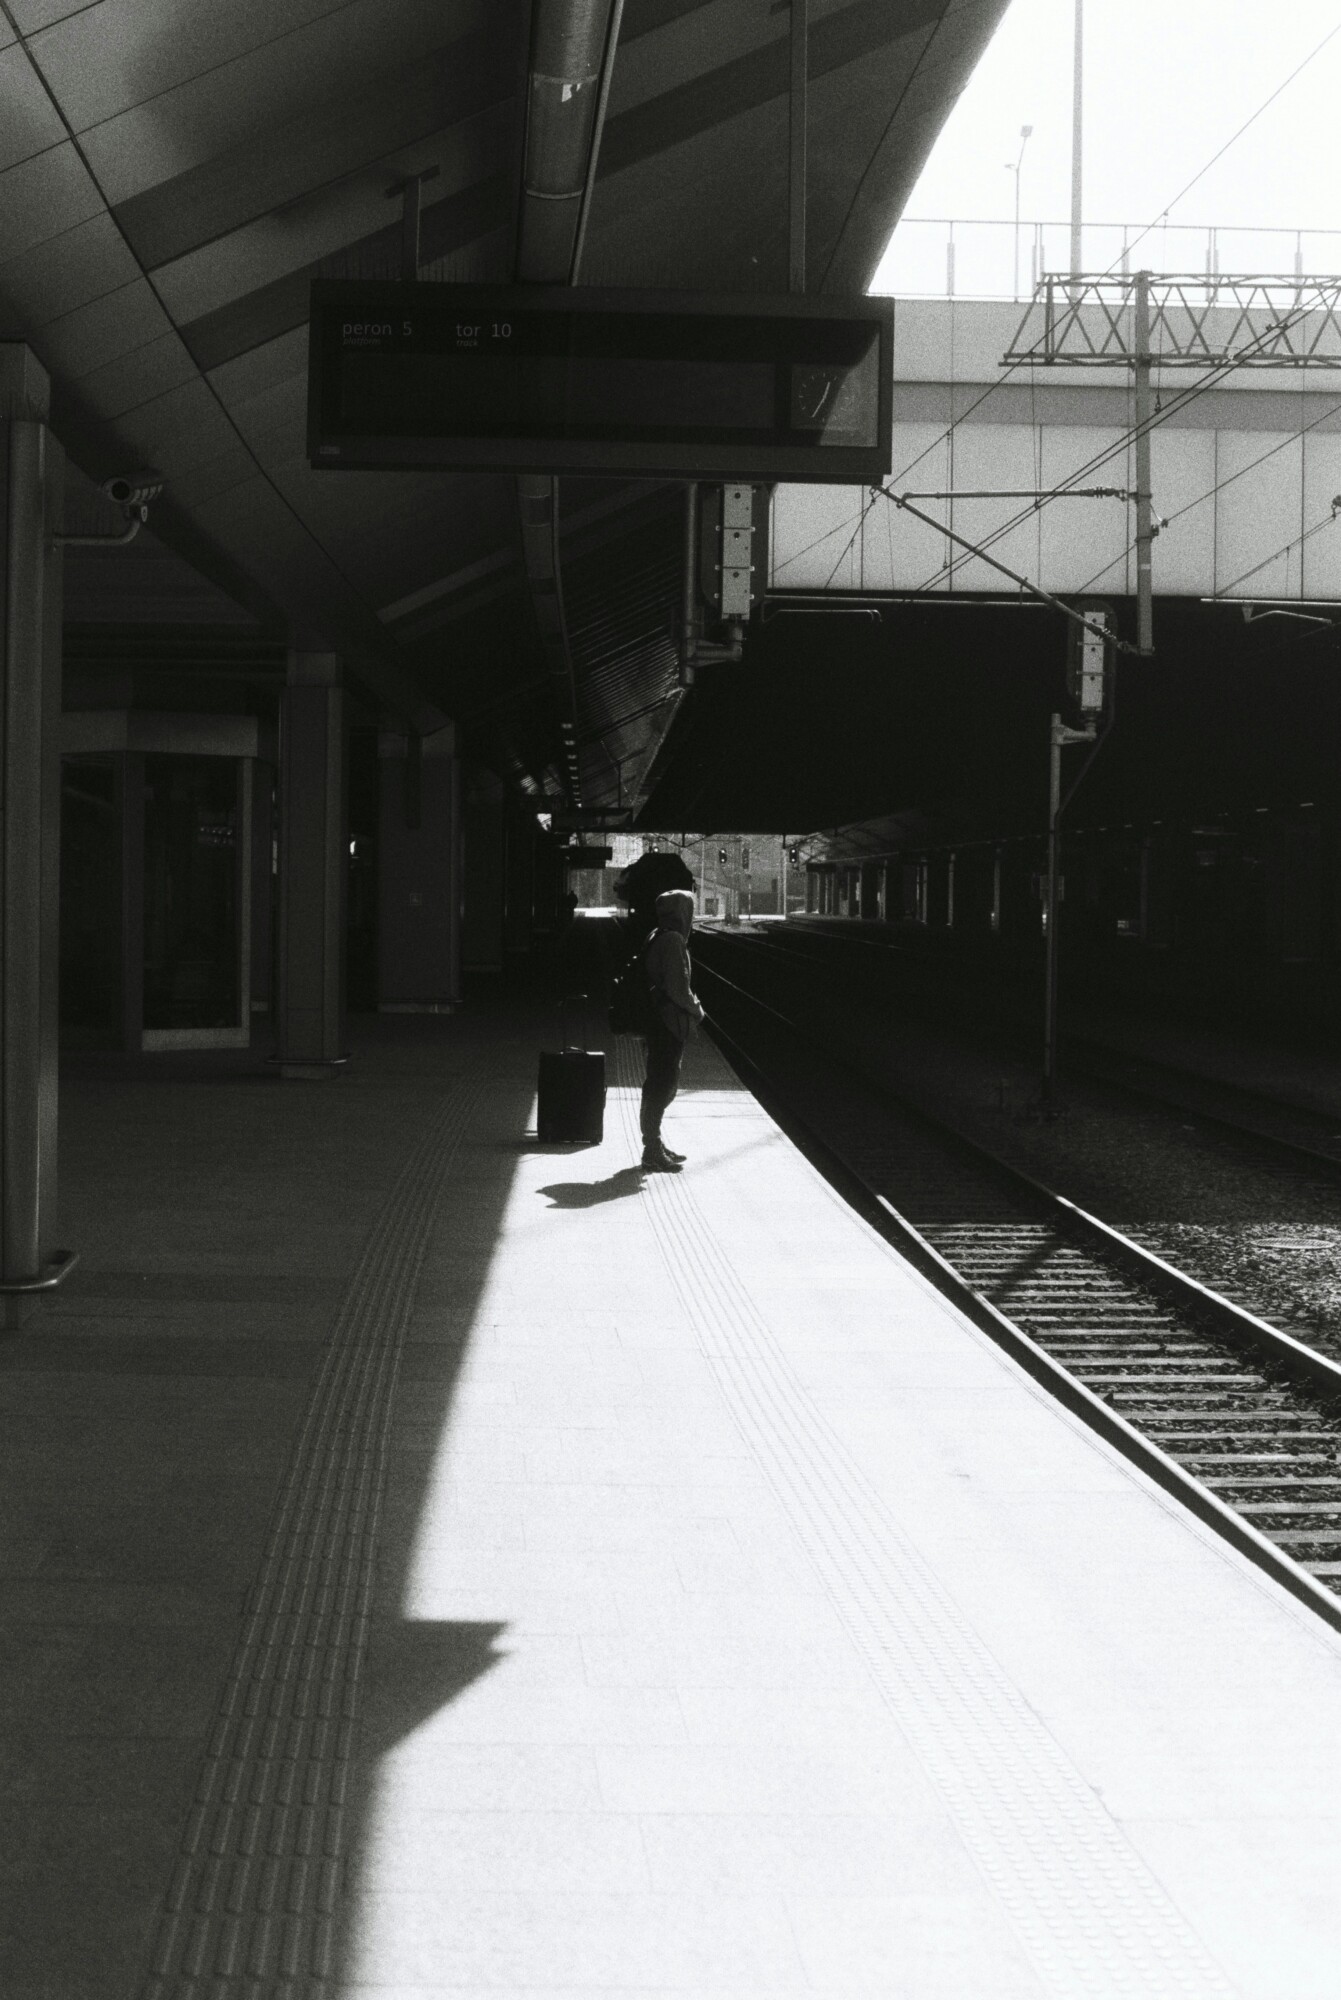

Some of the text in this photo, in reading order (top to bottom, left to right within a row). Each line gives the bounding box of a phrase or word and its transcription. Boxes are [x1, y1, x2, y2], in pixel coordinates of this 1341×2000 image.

[343, 321, 412, 338] peron 5
[456, 323, 512, 338] tor 10
